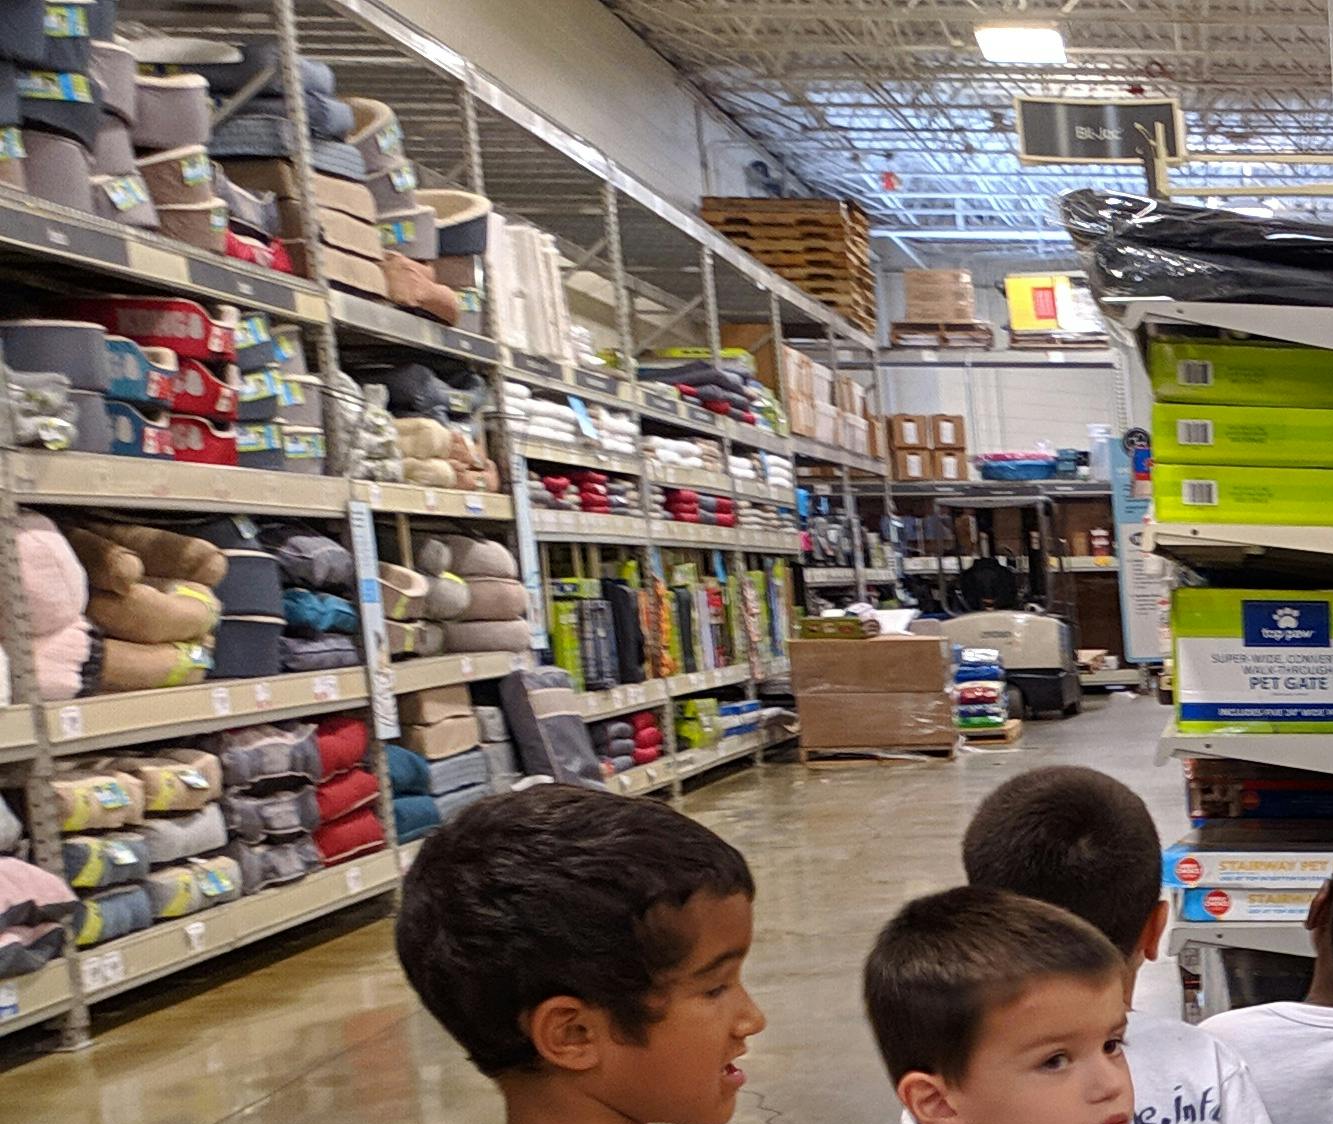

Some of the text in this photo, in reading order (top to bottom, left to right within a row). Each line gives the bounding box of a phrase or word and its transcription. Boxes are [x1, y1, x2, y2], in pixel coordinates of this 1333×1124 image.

[1284, 629, 1313, 641] paw
[1249, 676, 1330, 690] PET GATE
[1218, 859, 1329, 871] STAIRWAY PET
